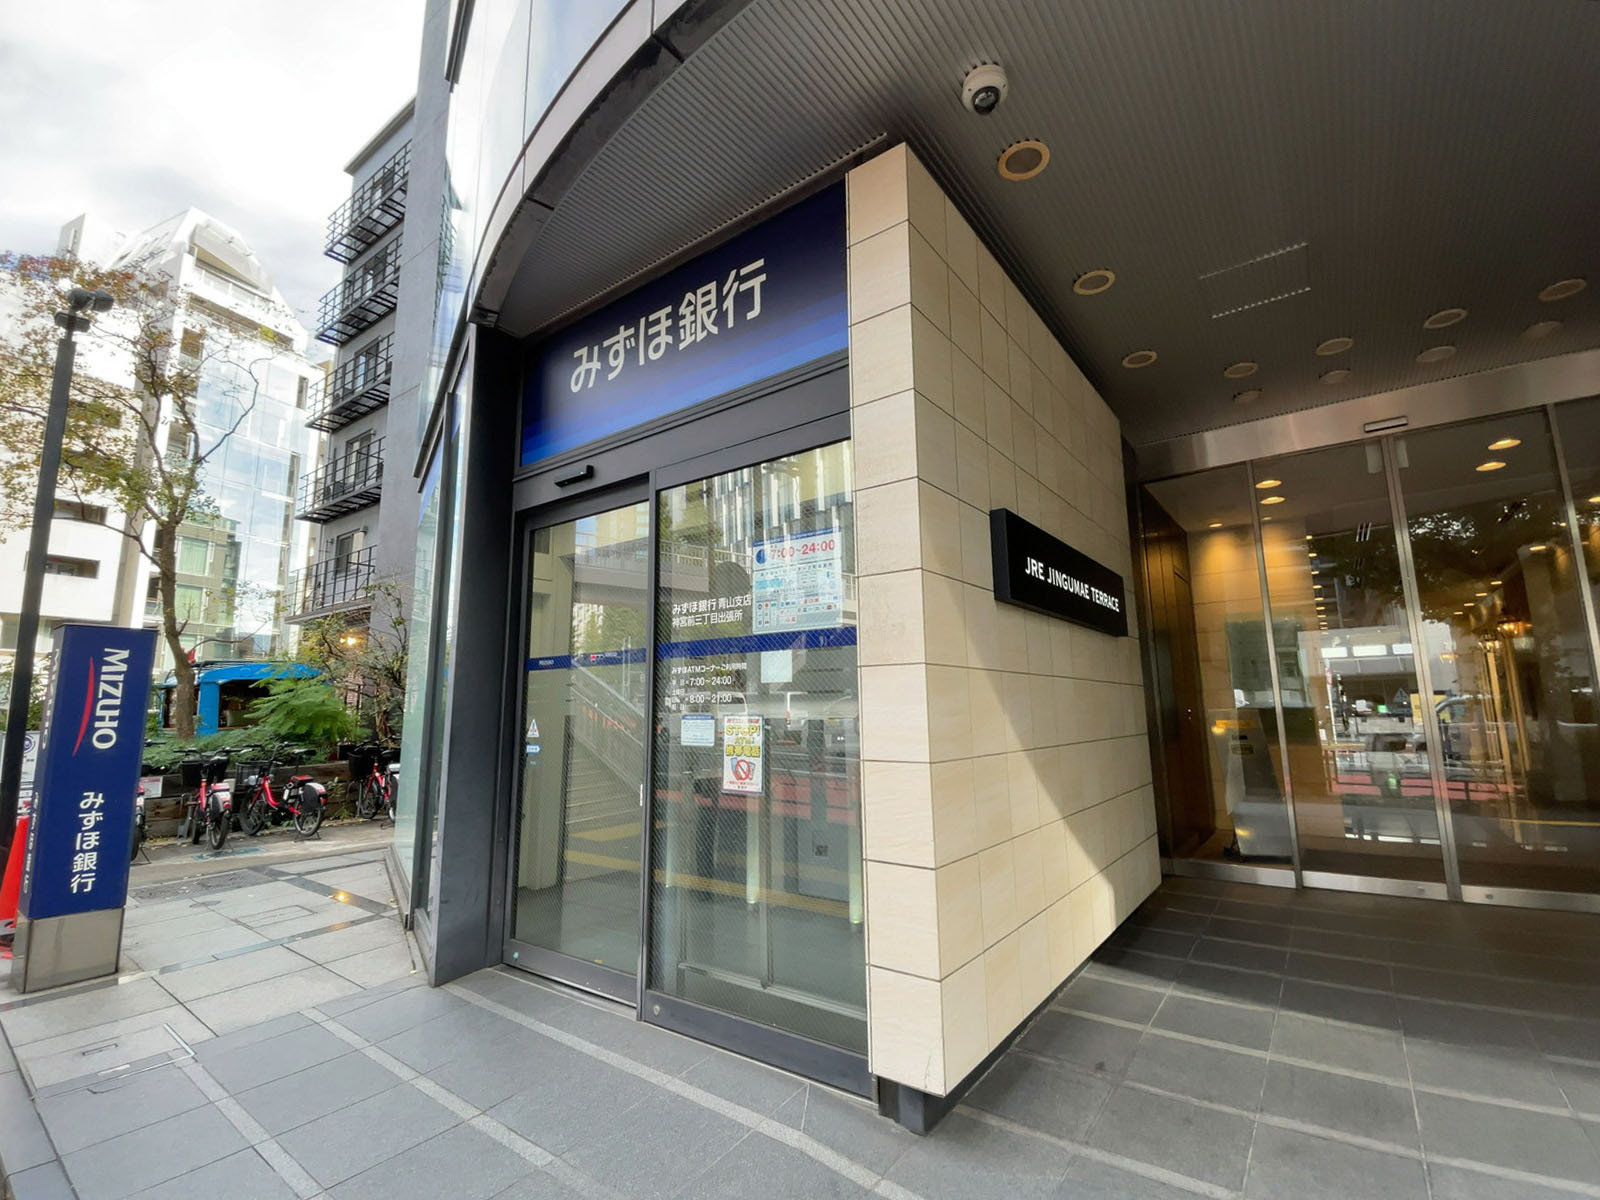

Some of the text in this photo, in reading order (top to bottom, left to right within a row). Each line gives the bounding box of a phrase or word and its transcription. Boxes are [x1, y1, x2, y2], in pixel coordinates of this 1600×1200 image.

[570, 258, 767, 393] みずほ銀行
[672, 594, 752, 615] みずほ銀行 青山支店
[672, 609, 743, 628] 神宮前三丁目出張所
[1025, 556, 1120, 612] JRE JINGUMAE TERRACE
[92, 647, 130, 750] MIZUHO
[70, 791, 104, 894] みずほ銀行
